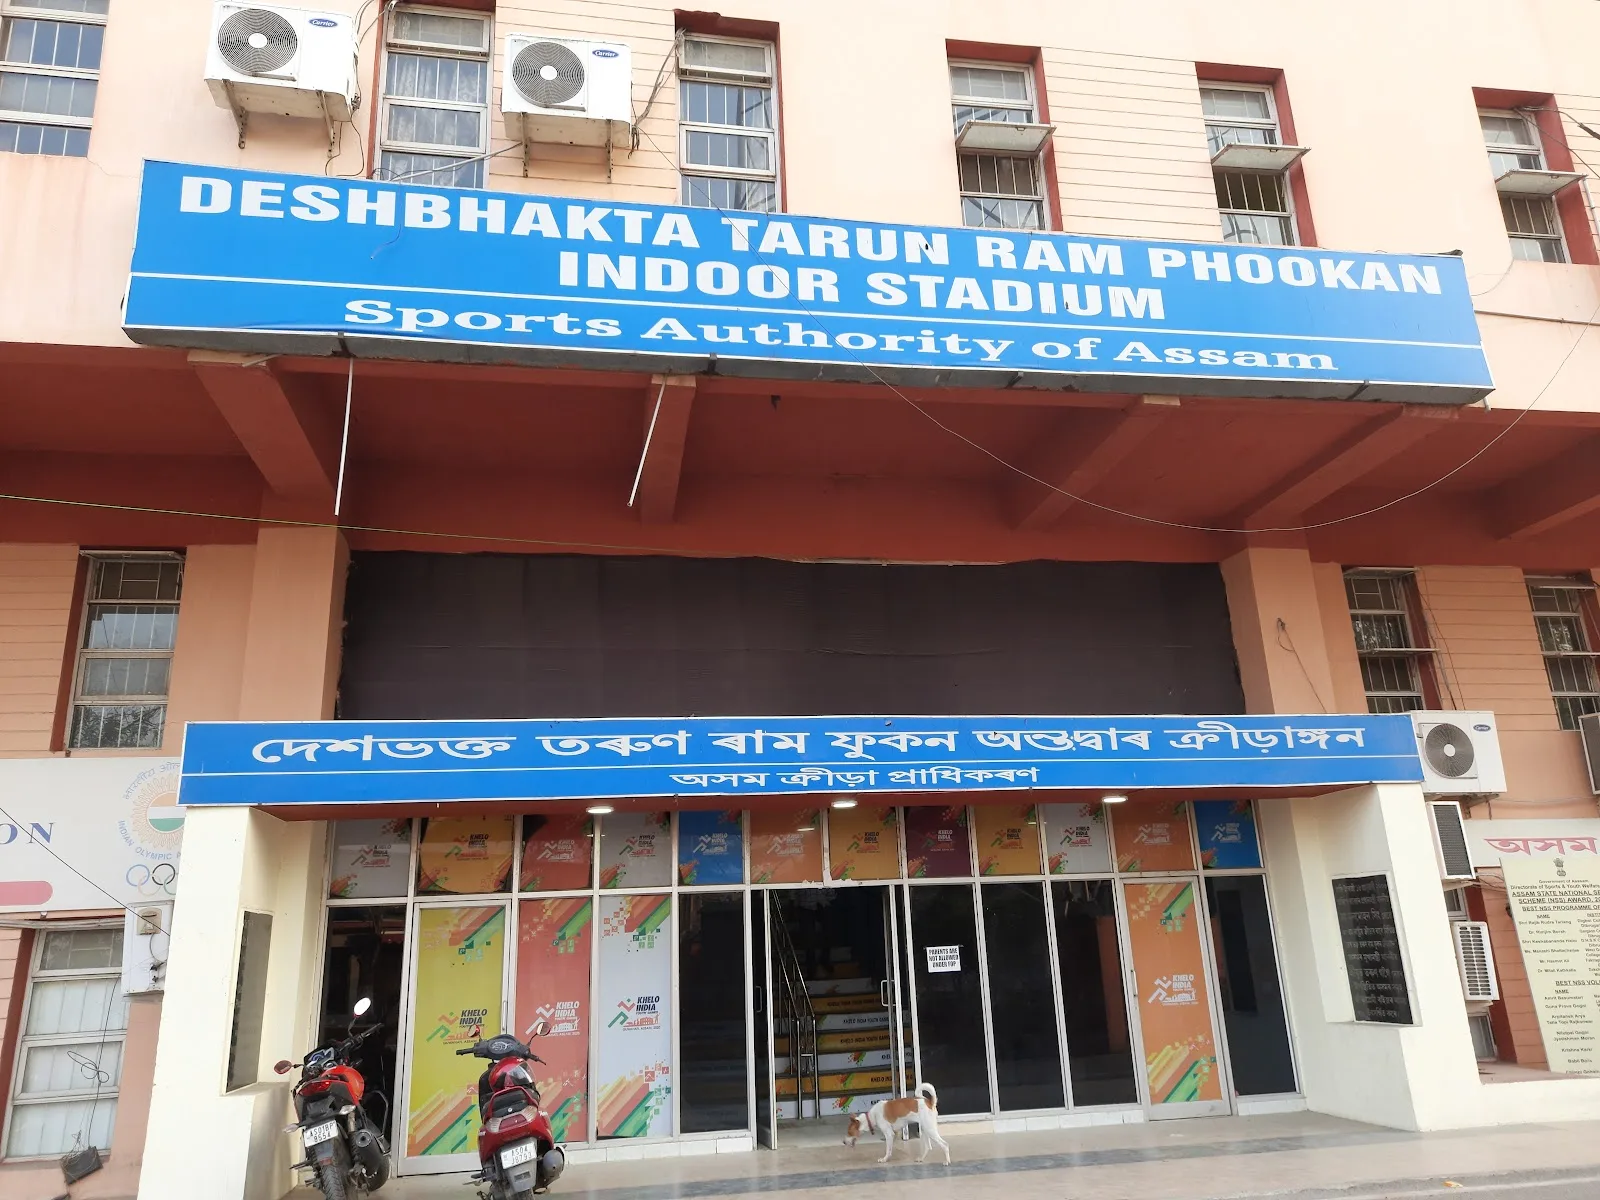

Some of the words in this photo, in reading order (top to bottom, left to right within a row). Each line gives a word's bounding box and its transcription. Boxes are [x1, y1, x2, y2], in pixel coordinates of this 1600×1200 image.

[181, 177, 700, 248] DESHBHAKTA
[721, 216, 949, 265] TARUN
[976, 235, 1124, 276] RAM
[1148, 247, 1441, 297] PHOOKAN
[560, 252, 839, 303] INDOOR
[866, 271, 1165, 319] STADIUM
[344, 299, 622, 337] Sports
[641, 317, 1014, 363] Authority
[1032, 337, 1102, 360] of
[1114, 342, 1338, 371] Assam
[252, 734, 516, 763] দেশভক্ত
[535, 730, 692, 757] তৰুণ
[708, 729, 810, 754] ৰাম
[831, 731, 958, 761] ফুকন
[669, 773, 770, 787] অসম
[118, 820, 135, 847] INDIAN
[135, 846, 172, 861] OLYMPIC
[1484, 836, 1597, 856] অসম
[1173, 974, 1195, 982] KHELO
[1173, 981, 1191, 989] INDIA
[637, 995, 660, 1004] KHELO
[556, 1001, 580, 1009] KHELO
[636, 1003, 656, 1011] INDIA
[461, 1009, 487, 1017] KHELO
[555, 1009, 575, 1017] INDIA
[460, 1017, 482, 1025] INDIA
